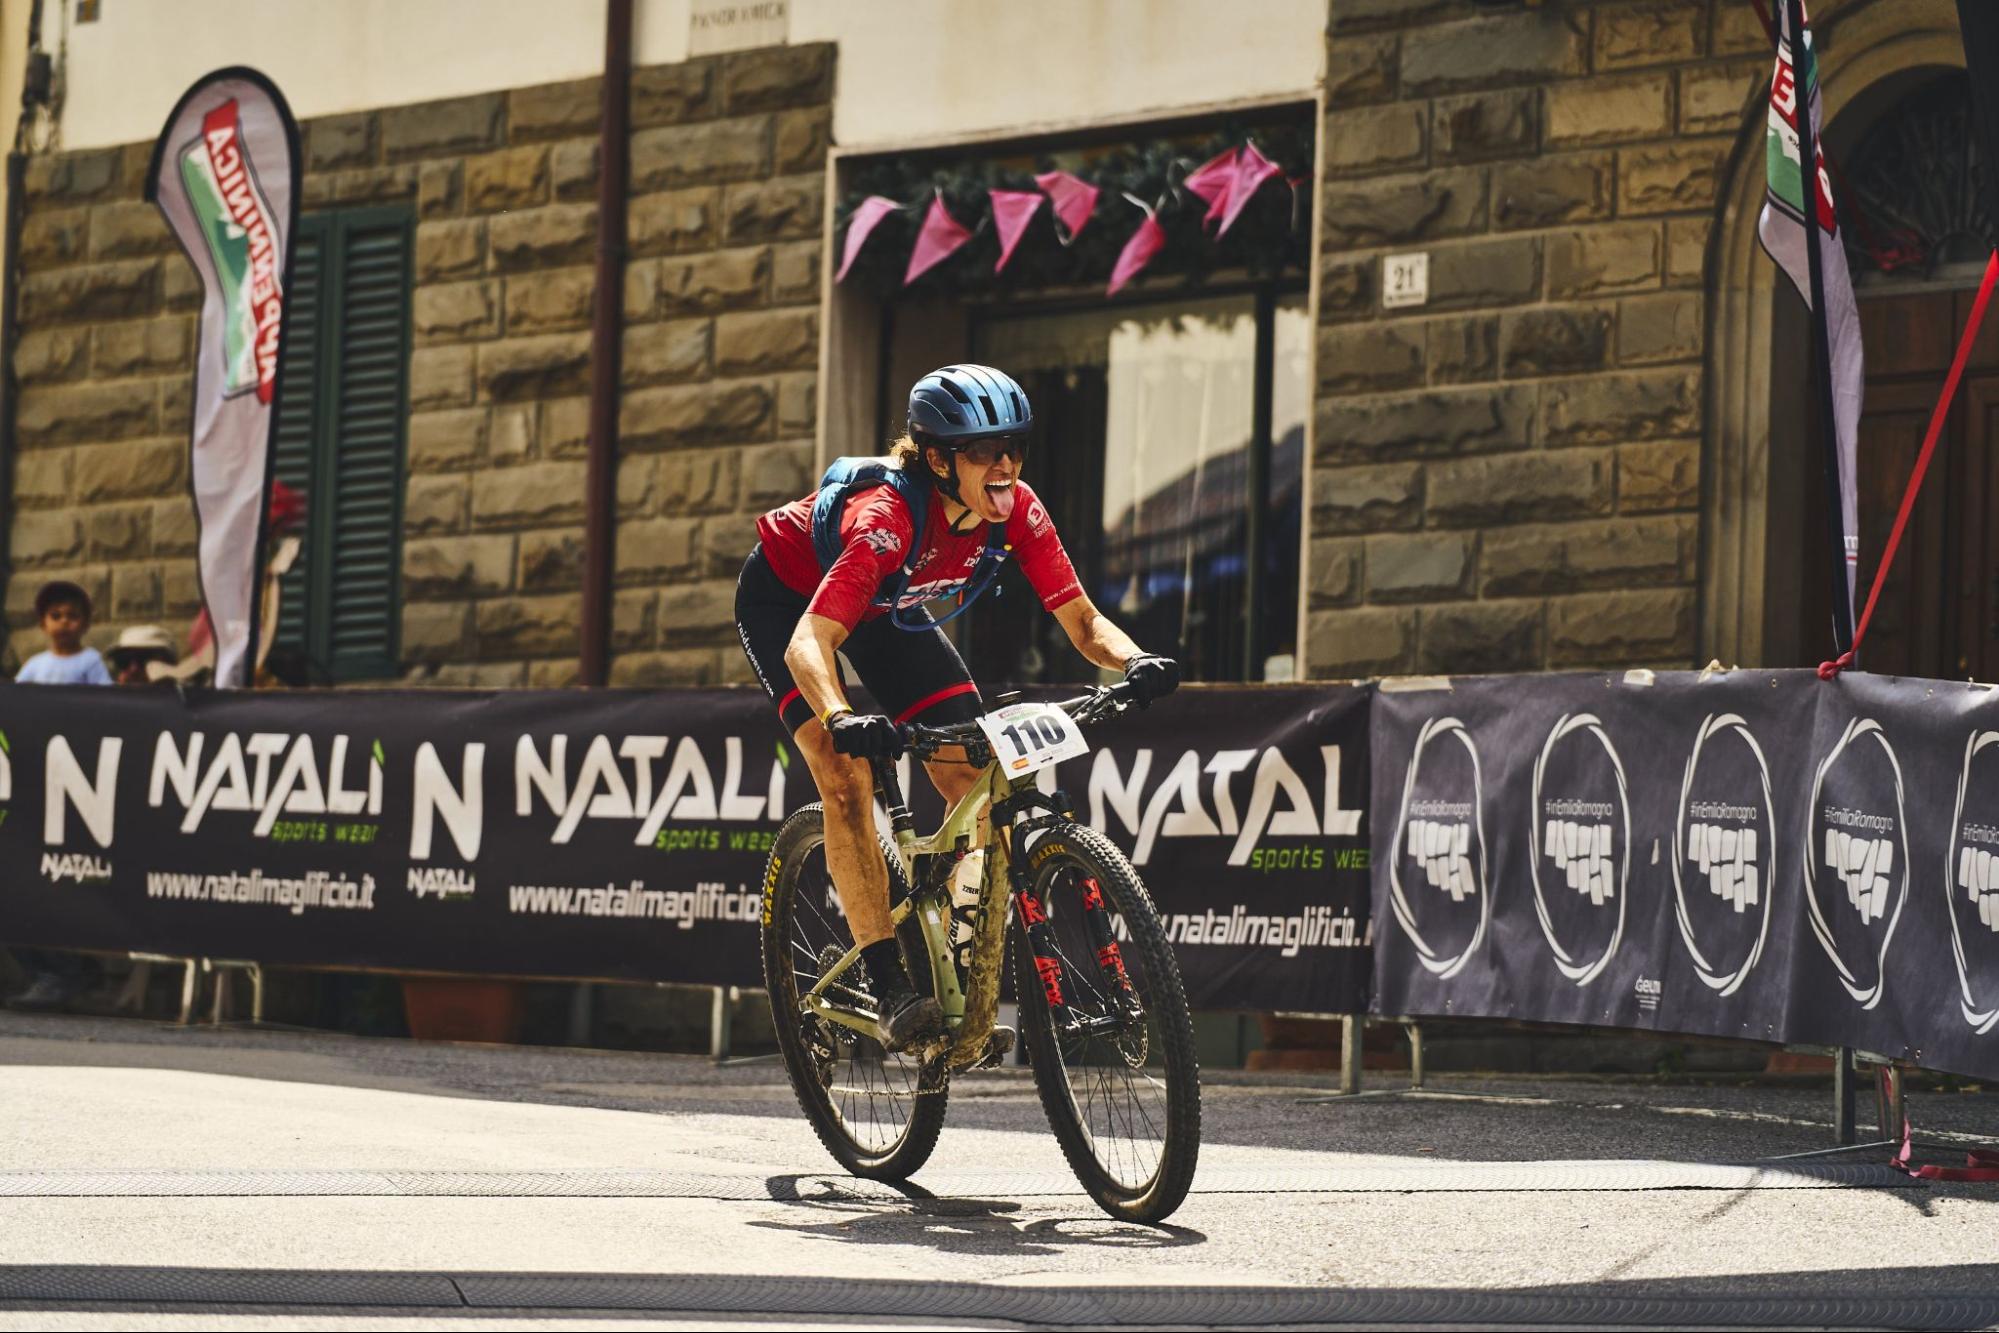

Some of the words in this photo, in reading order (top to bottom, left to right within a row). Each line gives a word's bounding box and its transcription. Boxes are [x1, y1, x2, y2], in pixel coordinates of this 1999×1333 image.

[1393, 264, 1413, 291] 21
[1001, 714, 1066, 756] 110
[44, 734, 124, 849] N
[409, 741, 486, 862] N
[271, 820, 327, 842] sports
[656, 826, 720, 852] sports
[1251, 845, 1324, 874] sports
[147, 868, 376, 915] www.natalimaglificio.it
[509, 880, 762, 930] www.natalimaglificio
[763, 856, 782, 926] MAXXIS
